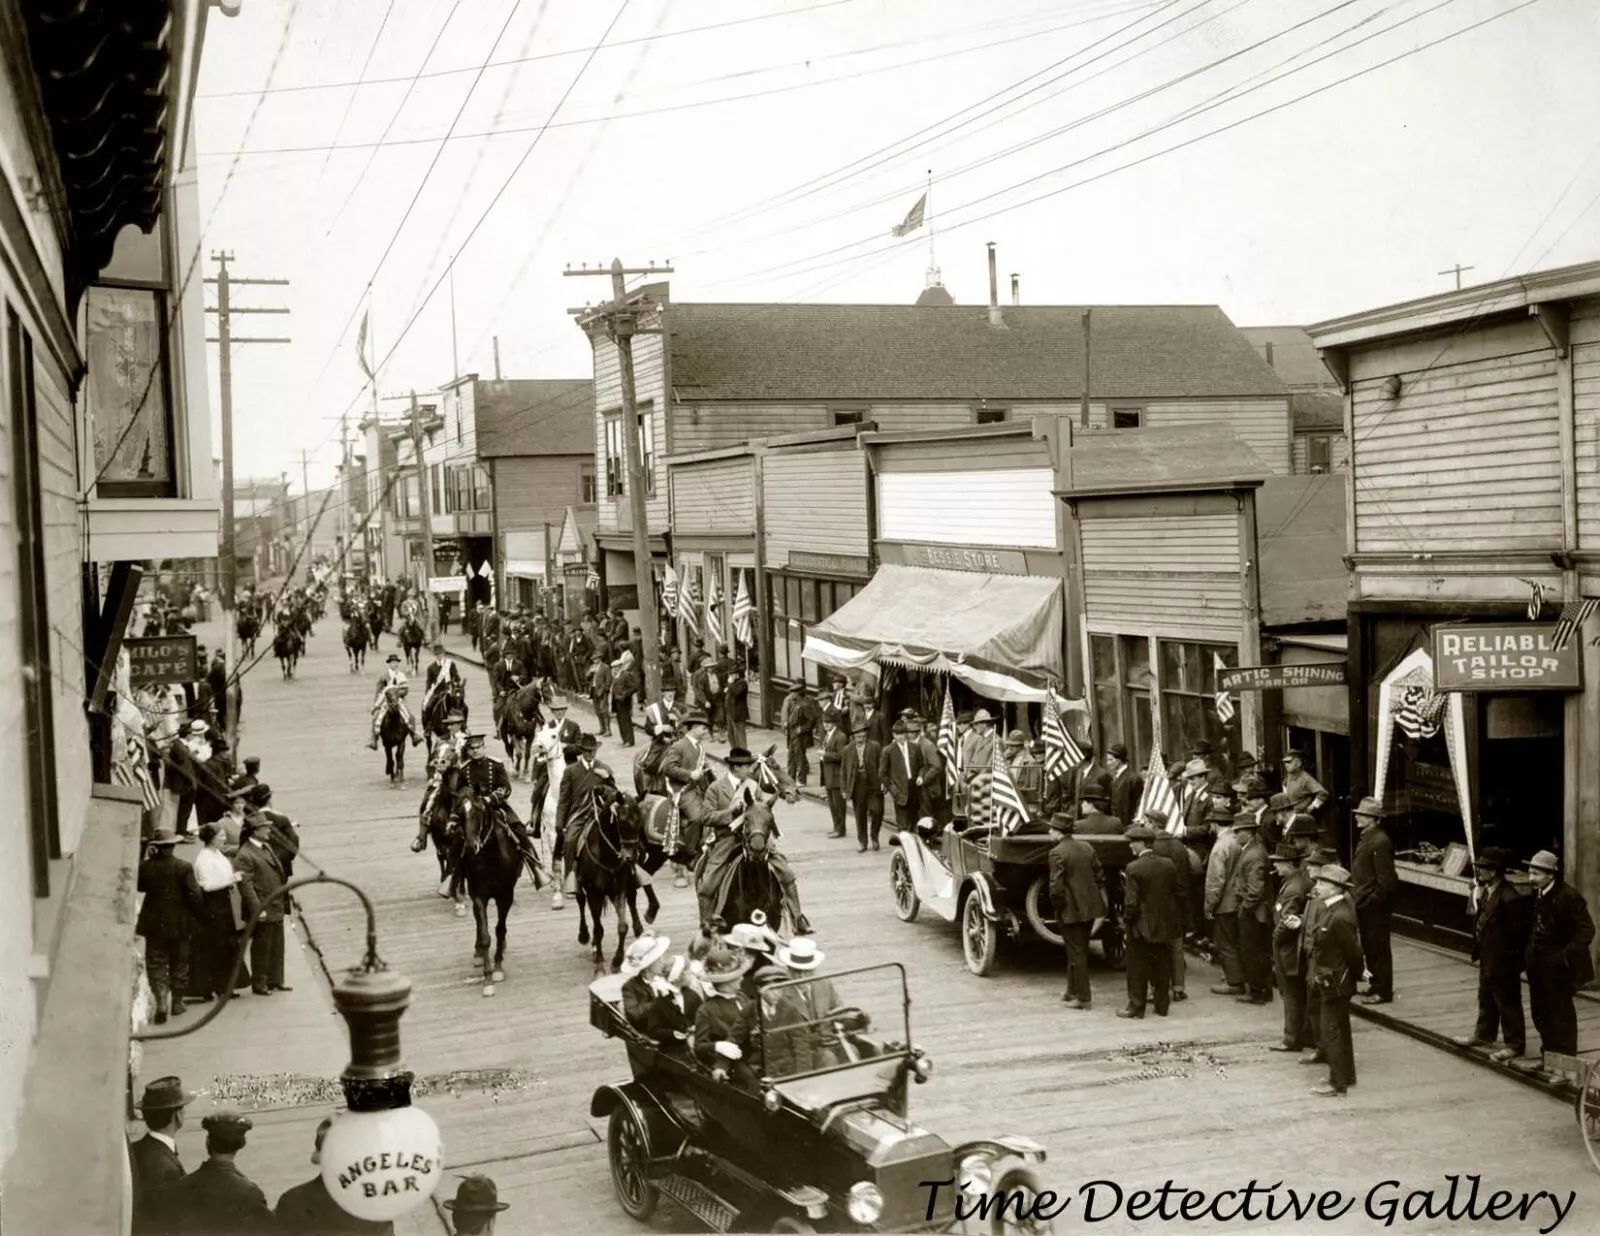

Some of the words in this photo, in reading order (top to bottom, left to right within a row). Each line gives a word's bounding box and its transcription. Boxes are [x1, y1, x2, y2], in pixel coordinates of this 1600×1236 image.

[963, 551, 1000, 568] STORE
[1443, 634, 1568, 656] RELIABL
[1452, 655, 1559, 674] TAILOR
[1471, 668, 1545, 679] SHOP
[1222, 668, 1270, 689] ARTIC
[1282, 667, 1345, 681] SHINING
[1254, 678, 1309, 688] PARLOR
[362, 1176, 420, 1198] BAR
